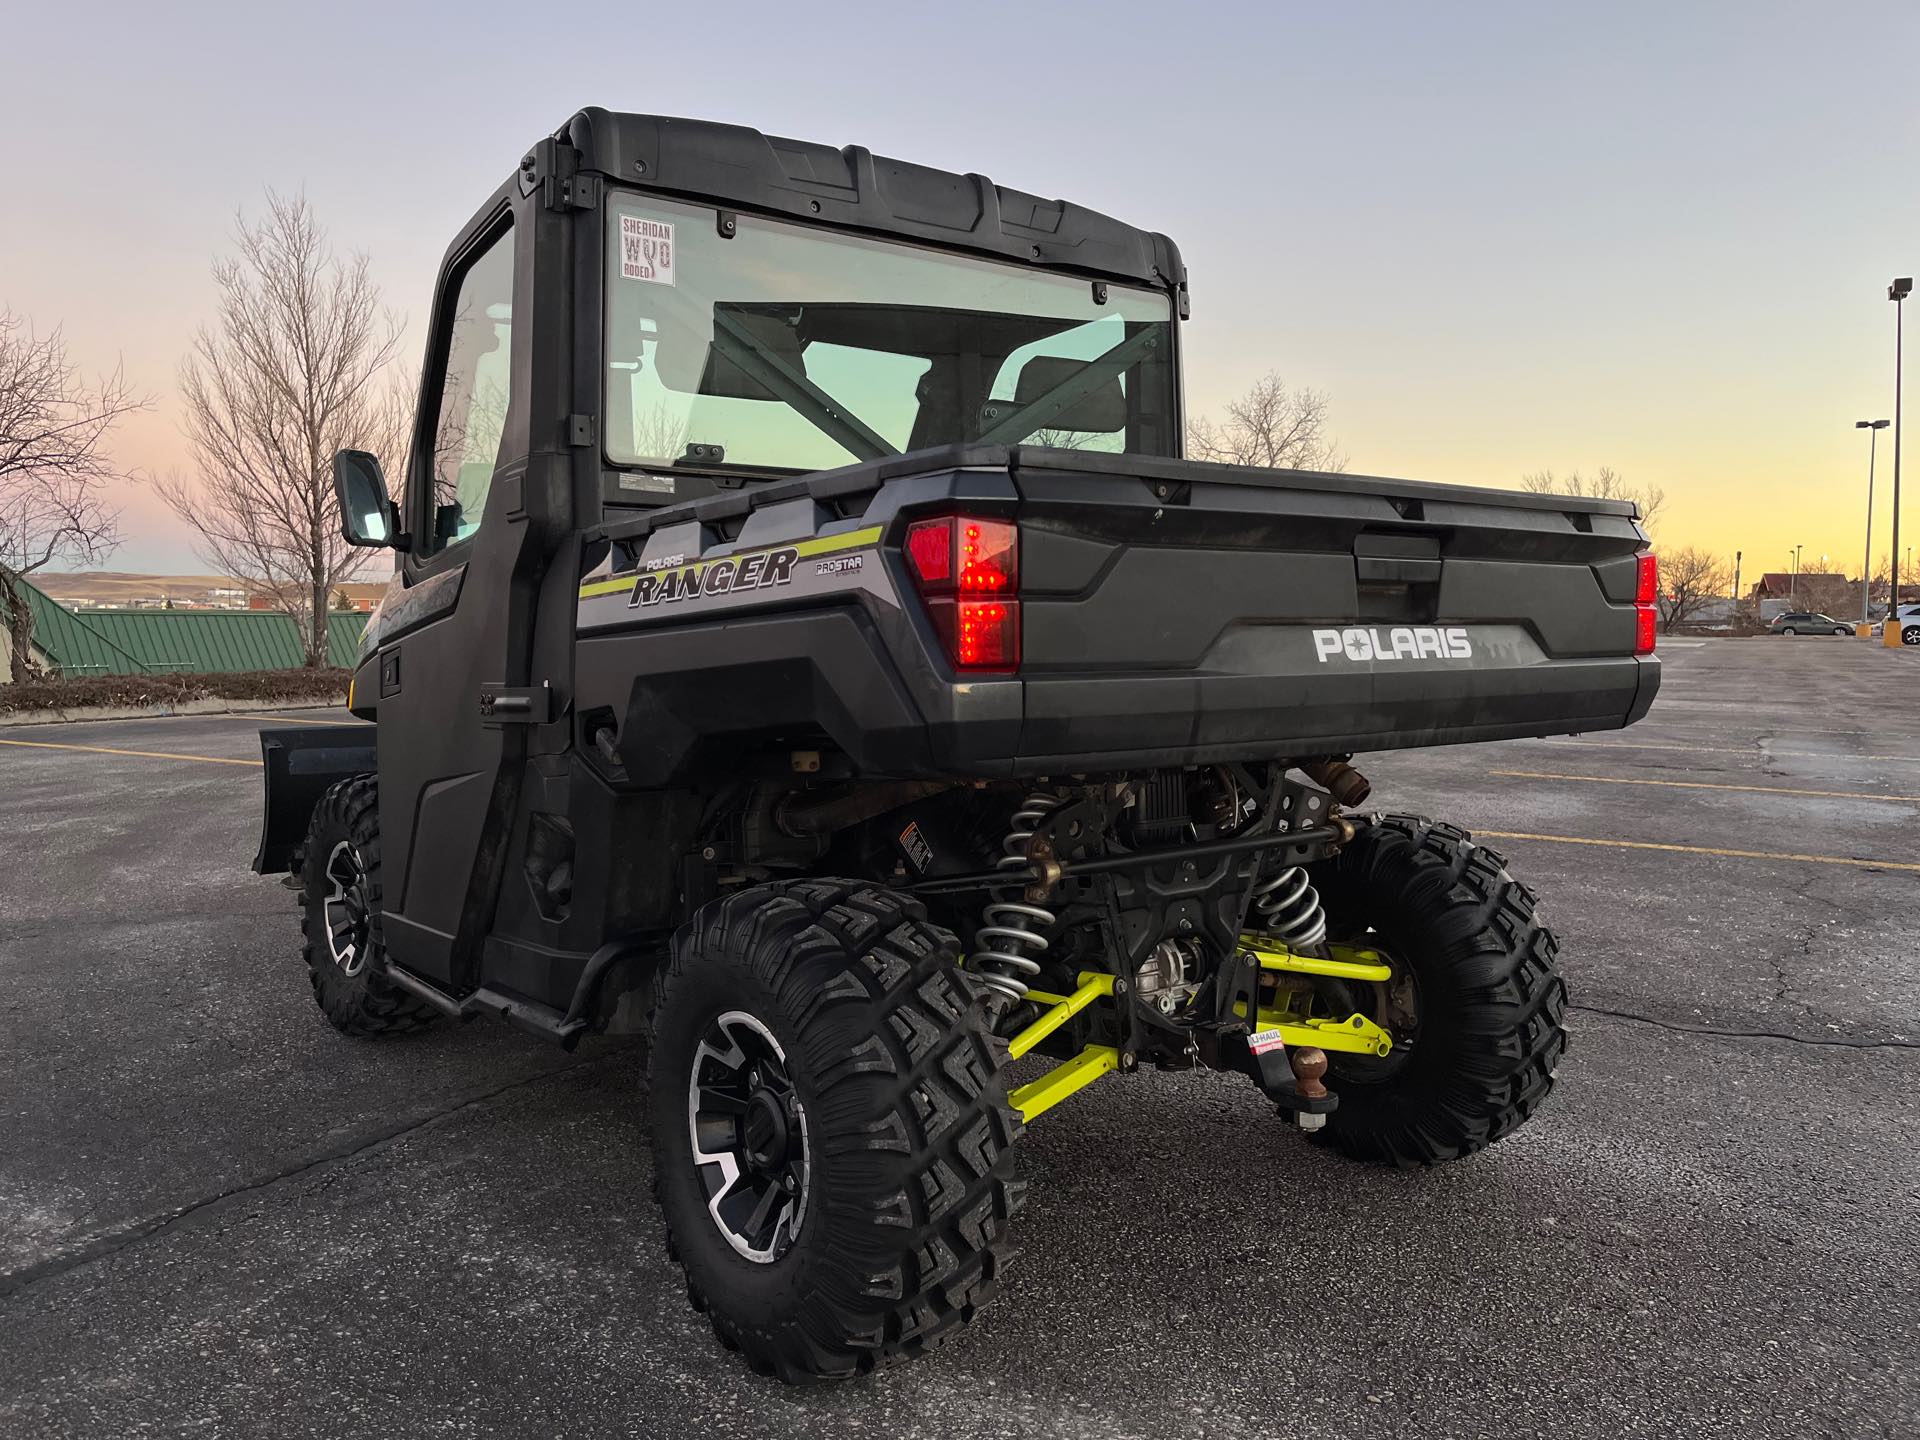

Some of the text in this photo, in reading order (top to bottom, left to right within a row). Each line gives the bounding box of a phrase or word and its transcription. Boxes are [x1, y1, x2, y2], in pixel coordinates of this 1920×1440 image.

[623, 218, 670, 240] SHERIDAN
[624, 234, 671, 277] WYO
[624, 263, 650, 279] RODEO
[646, 553, 684, 571] POLARIS
[816, 556, 862, 576] PROSTAR
[628, 546, 799, 608] RANGER
[1312, 628, 1472, 662] POLARIS
[1251, 1031, 1280, 1043] U-HAUL
